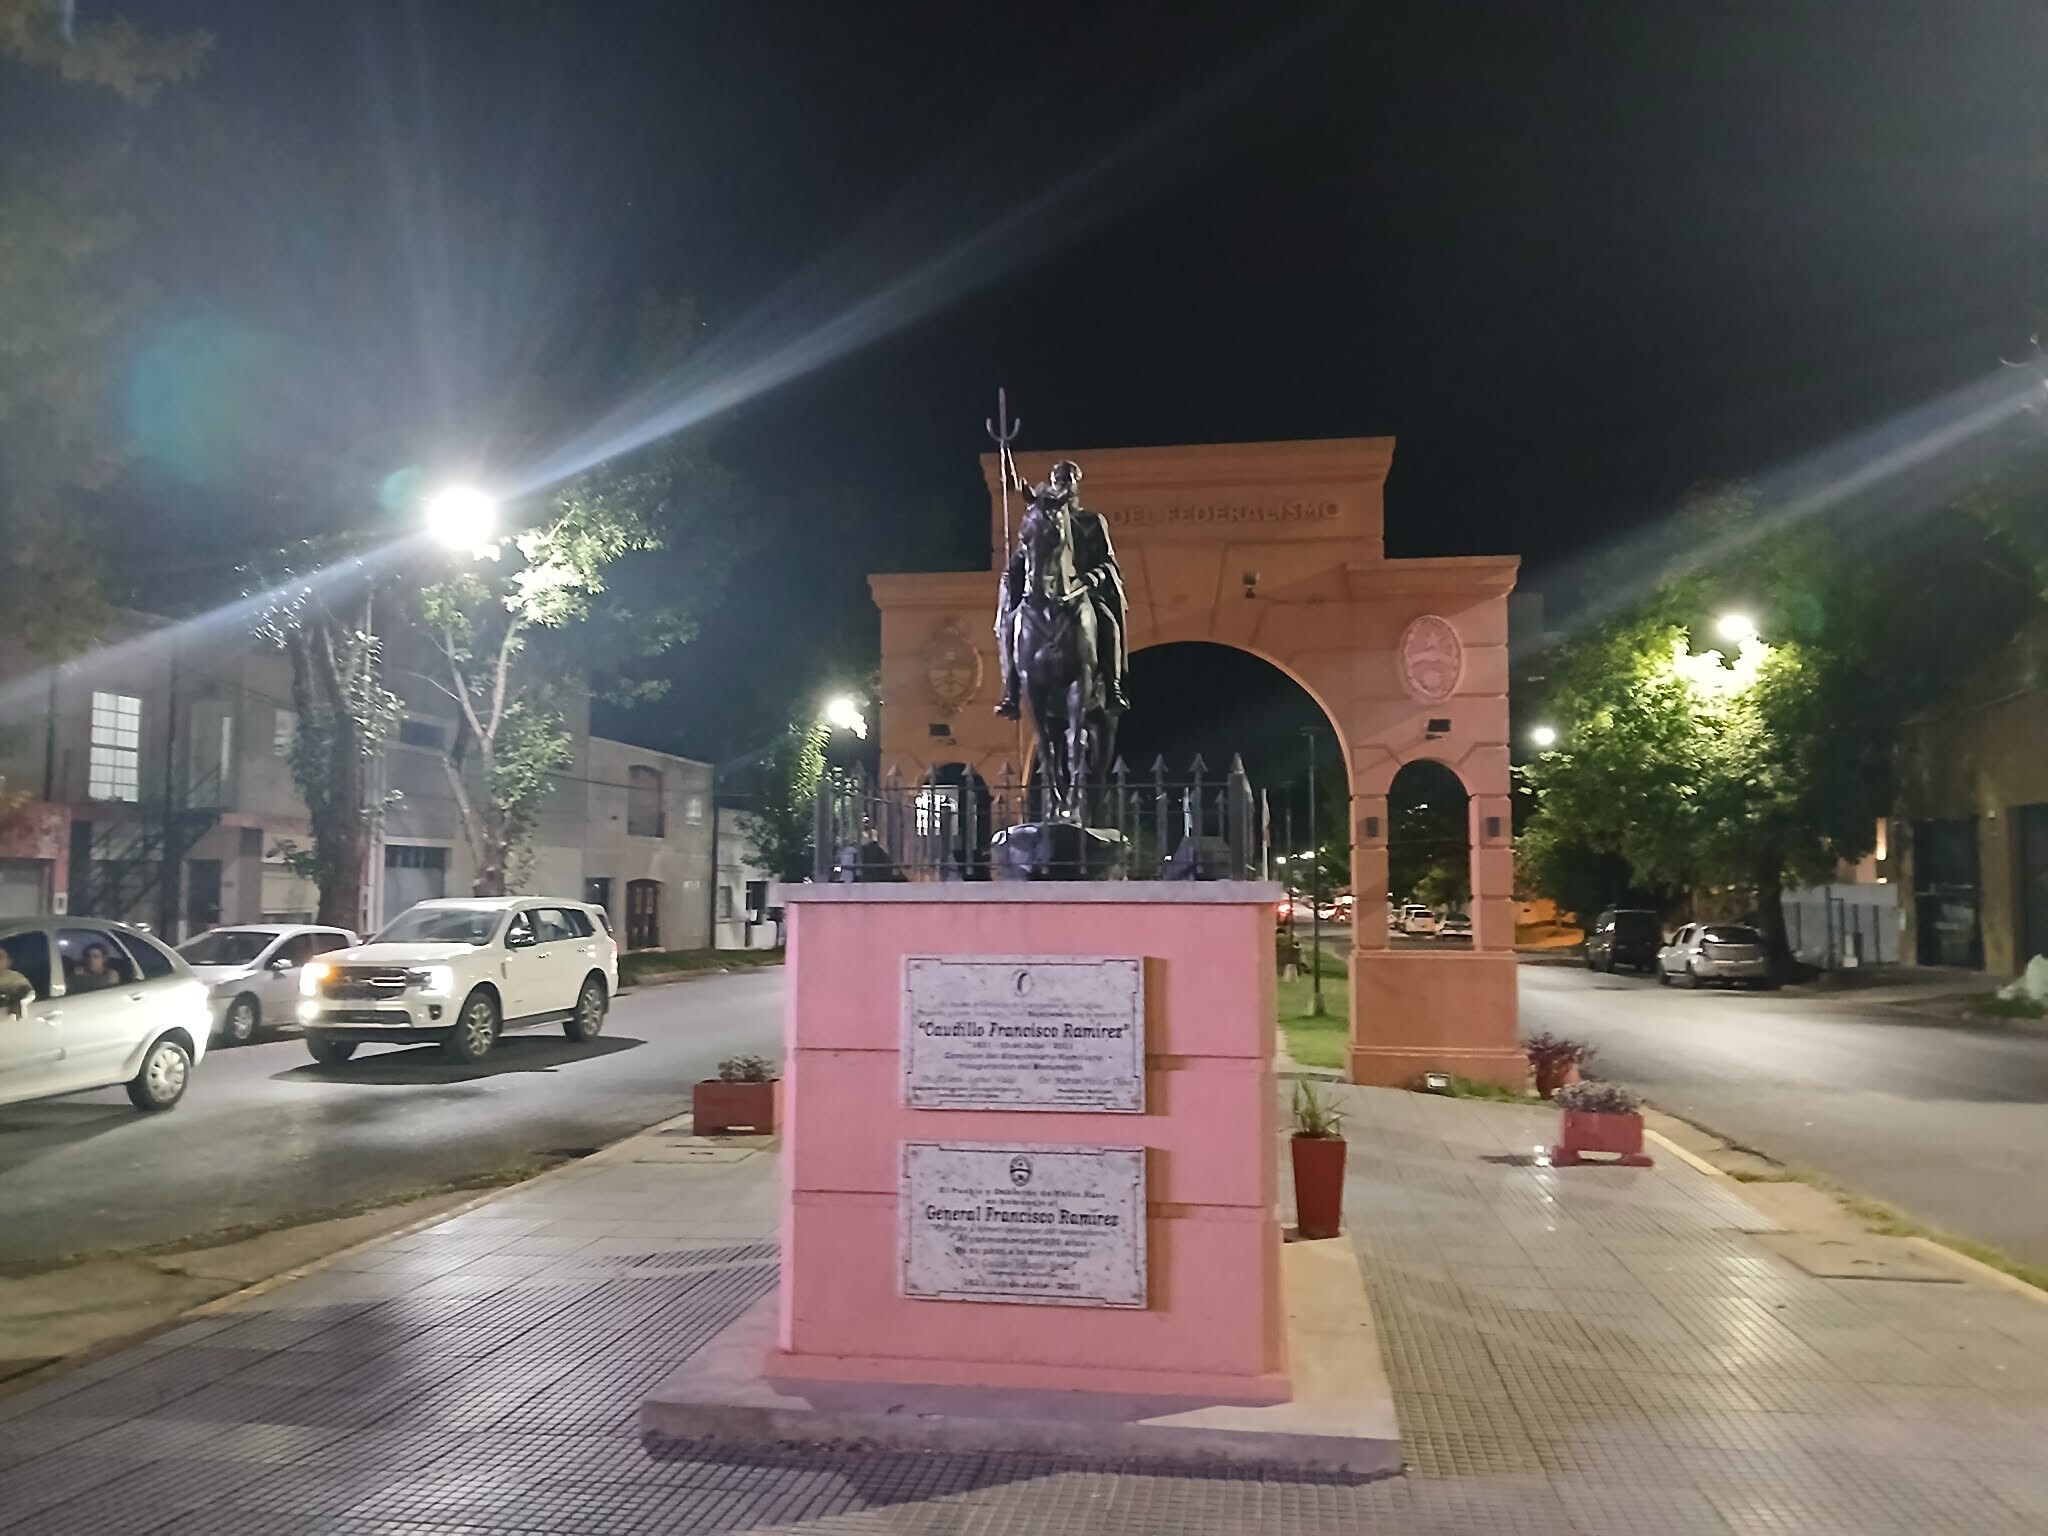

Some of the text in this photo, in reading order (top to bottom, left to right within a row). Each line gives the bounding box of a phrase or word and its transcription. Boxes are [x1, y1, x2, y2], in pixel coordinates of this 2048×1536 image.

[1166, 498, 1341, 522] FEDERALISMO
[987, 1021, 1059, 1038] Francisco
[927, 1203, 981, 1221] General
[984, 1205, 1056, 1224] Francisco
